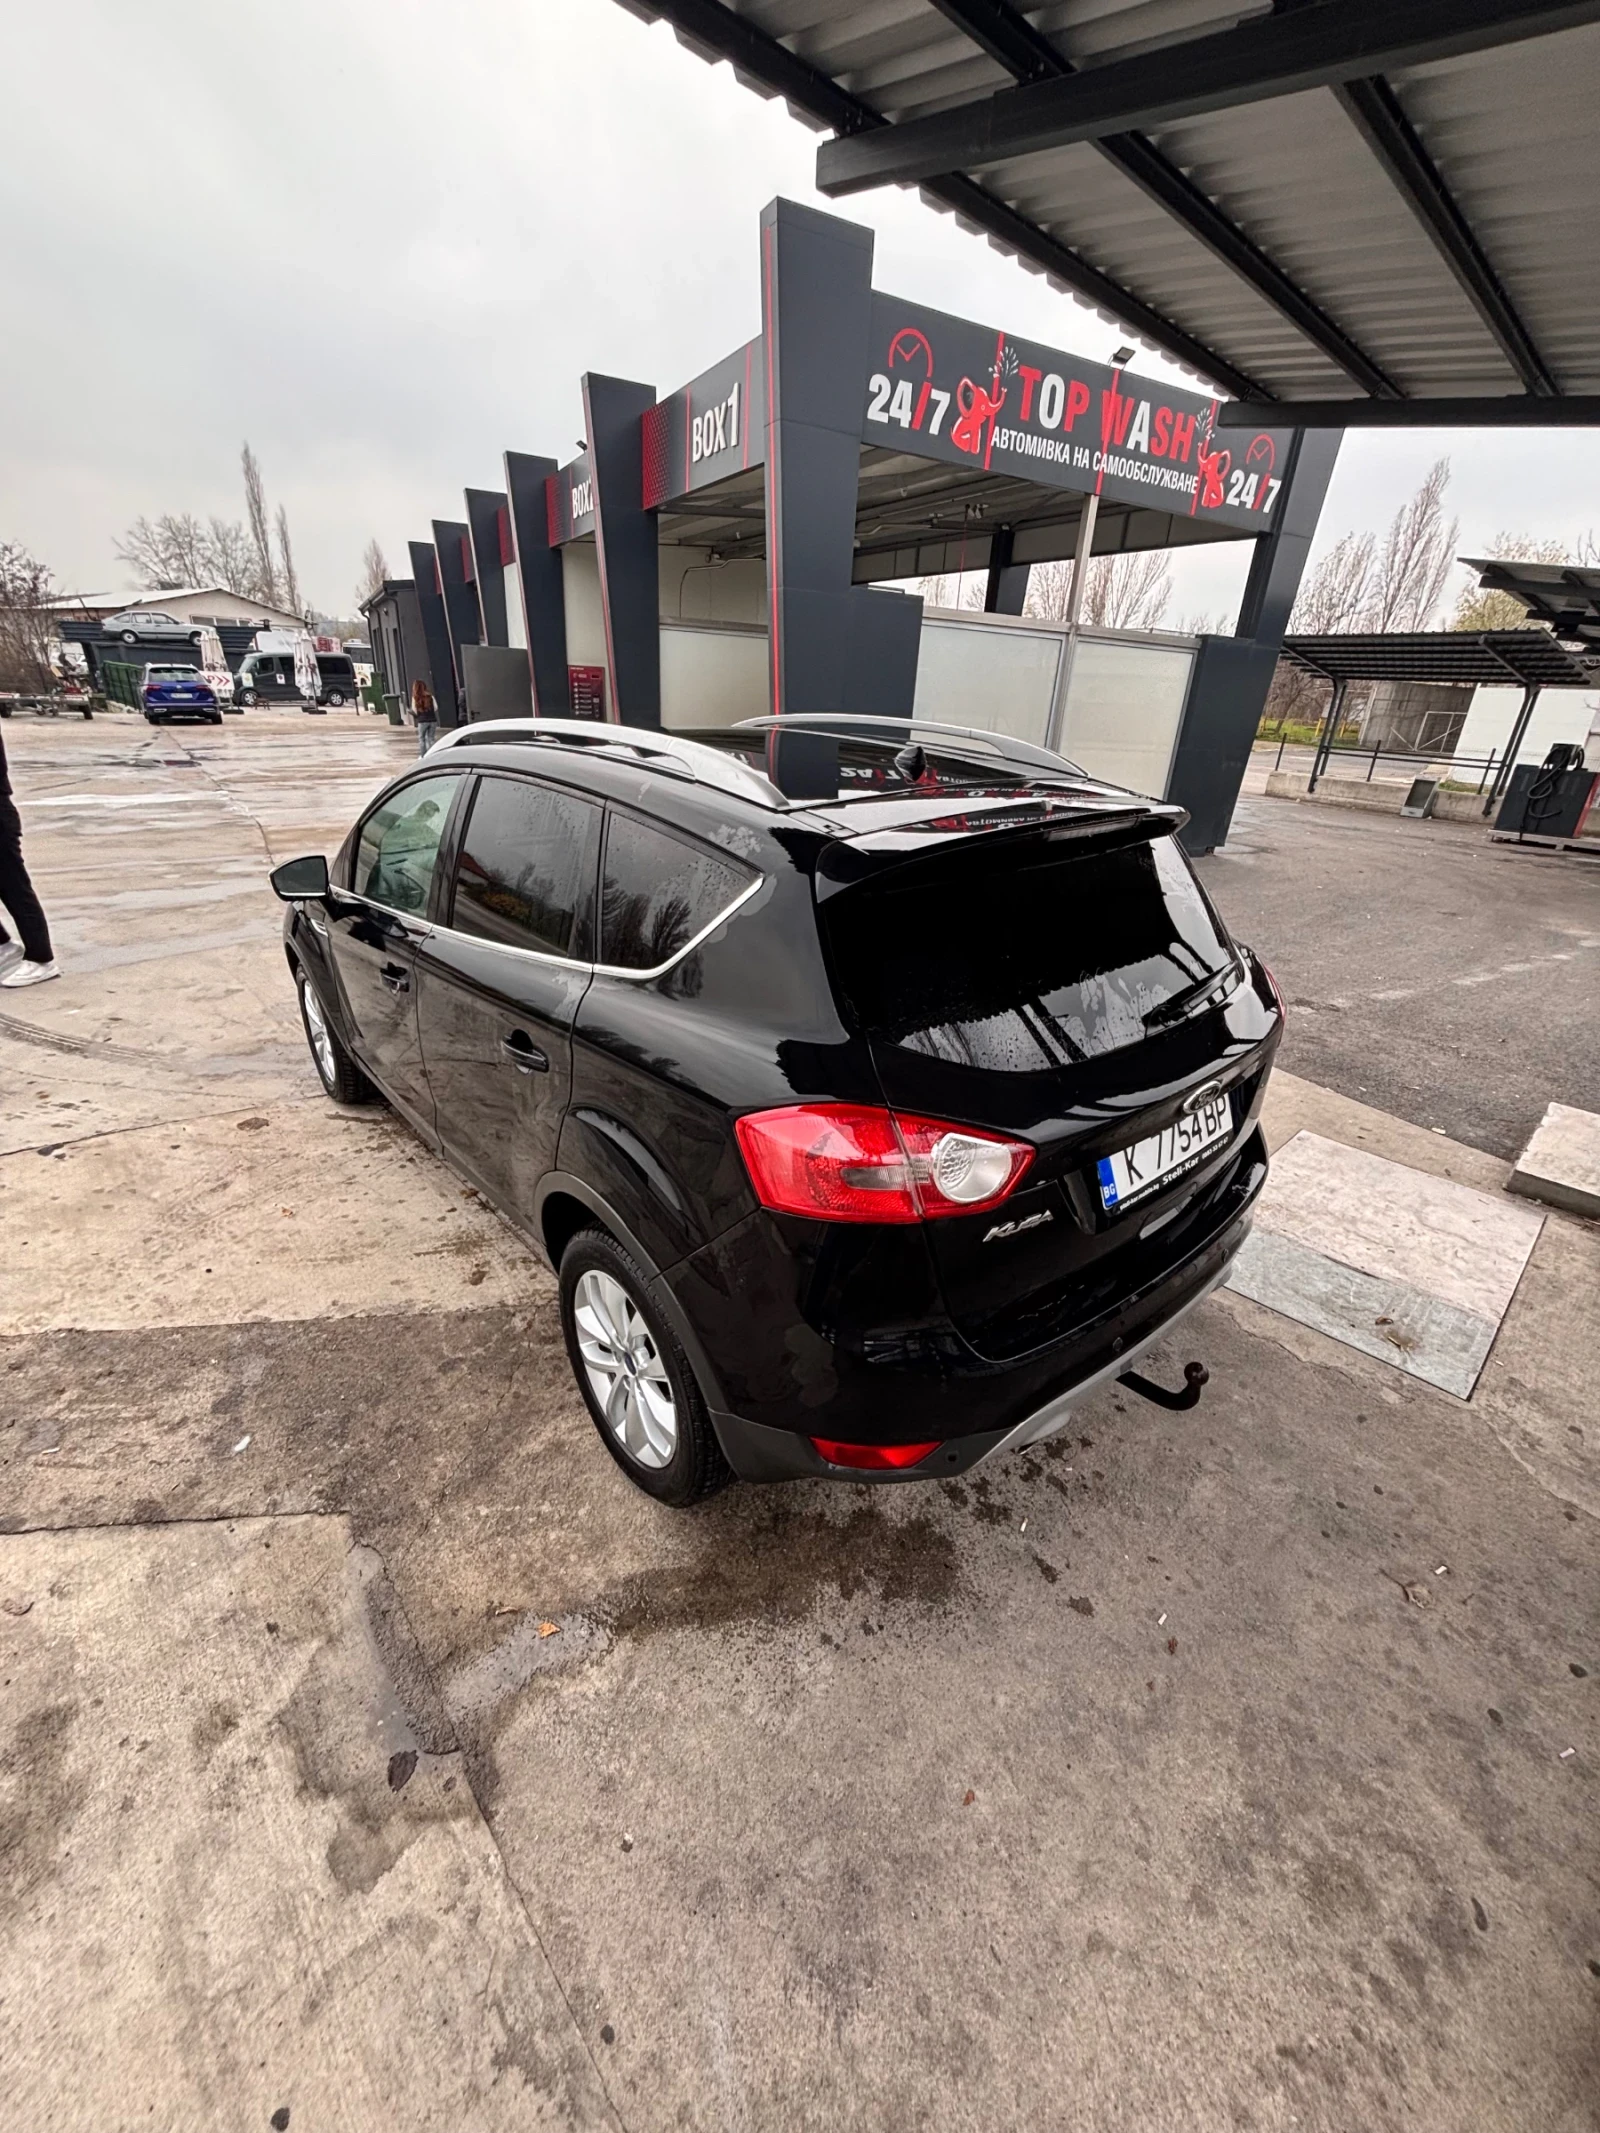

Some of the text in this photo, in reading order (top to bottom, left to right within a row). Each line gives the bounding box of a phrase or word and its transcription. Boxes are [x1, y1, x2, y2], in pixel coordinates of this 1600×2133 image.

[867, 373, 951, 435] 24/7
[1018, 365, 1196, 463] TOP WASH
[991, 426, 1199, 495] АВТОМИВКА НА САМООБСЛУЖВАНЕ
[1226, 469, 1282, 514] 24/7
[1124, 1145, 1144, 1186] K
[1204, 1096, 1227, 1138] BP
[1103, 1183, 1116, 1199] BG
